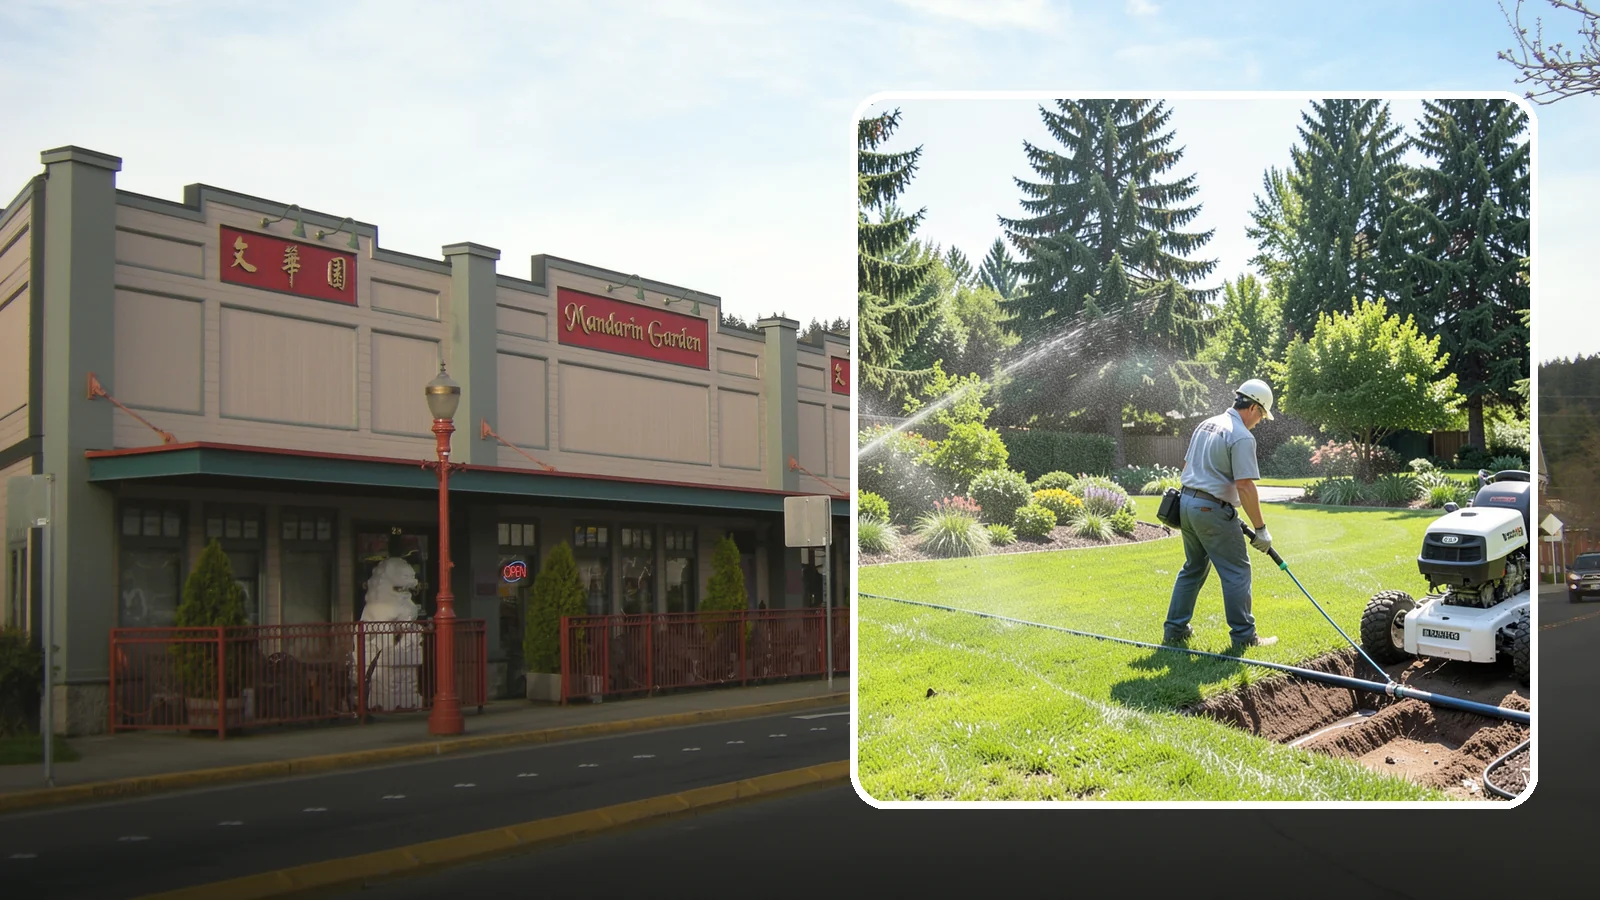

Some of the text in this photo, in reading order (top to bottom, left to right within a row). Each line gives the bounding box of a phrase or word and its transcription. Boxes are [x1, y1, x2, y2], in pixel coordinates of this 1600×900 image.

[231, 235, 346, 291] 文華園
[564, 302, 701, 352] Mandarin Garden
[503, 565, 526, 578] OPEN
